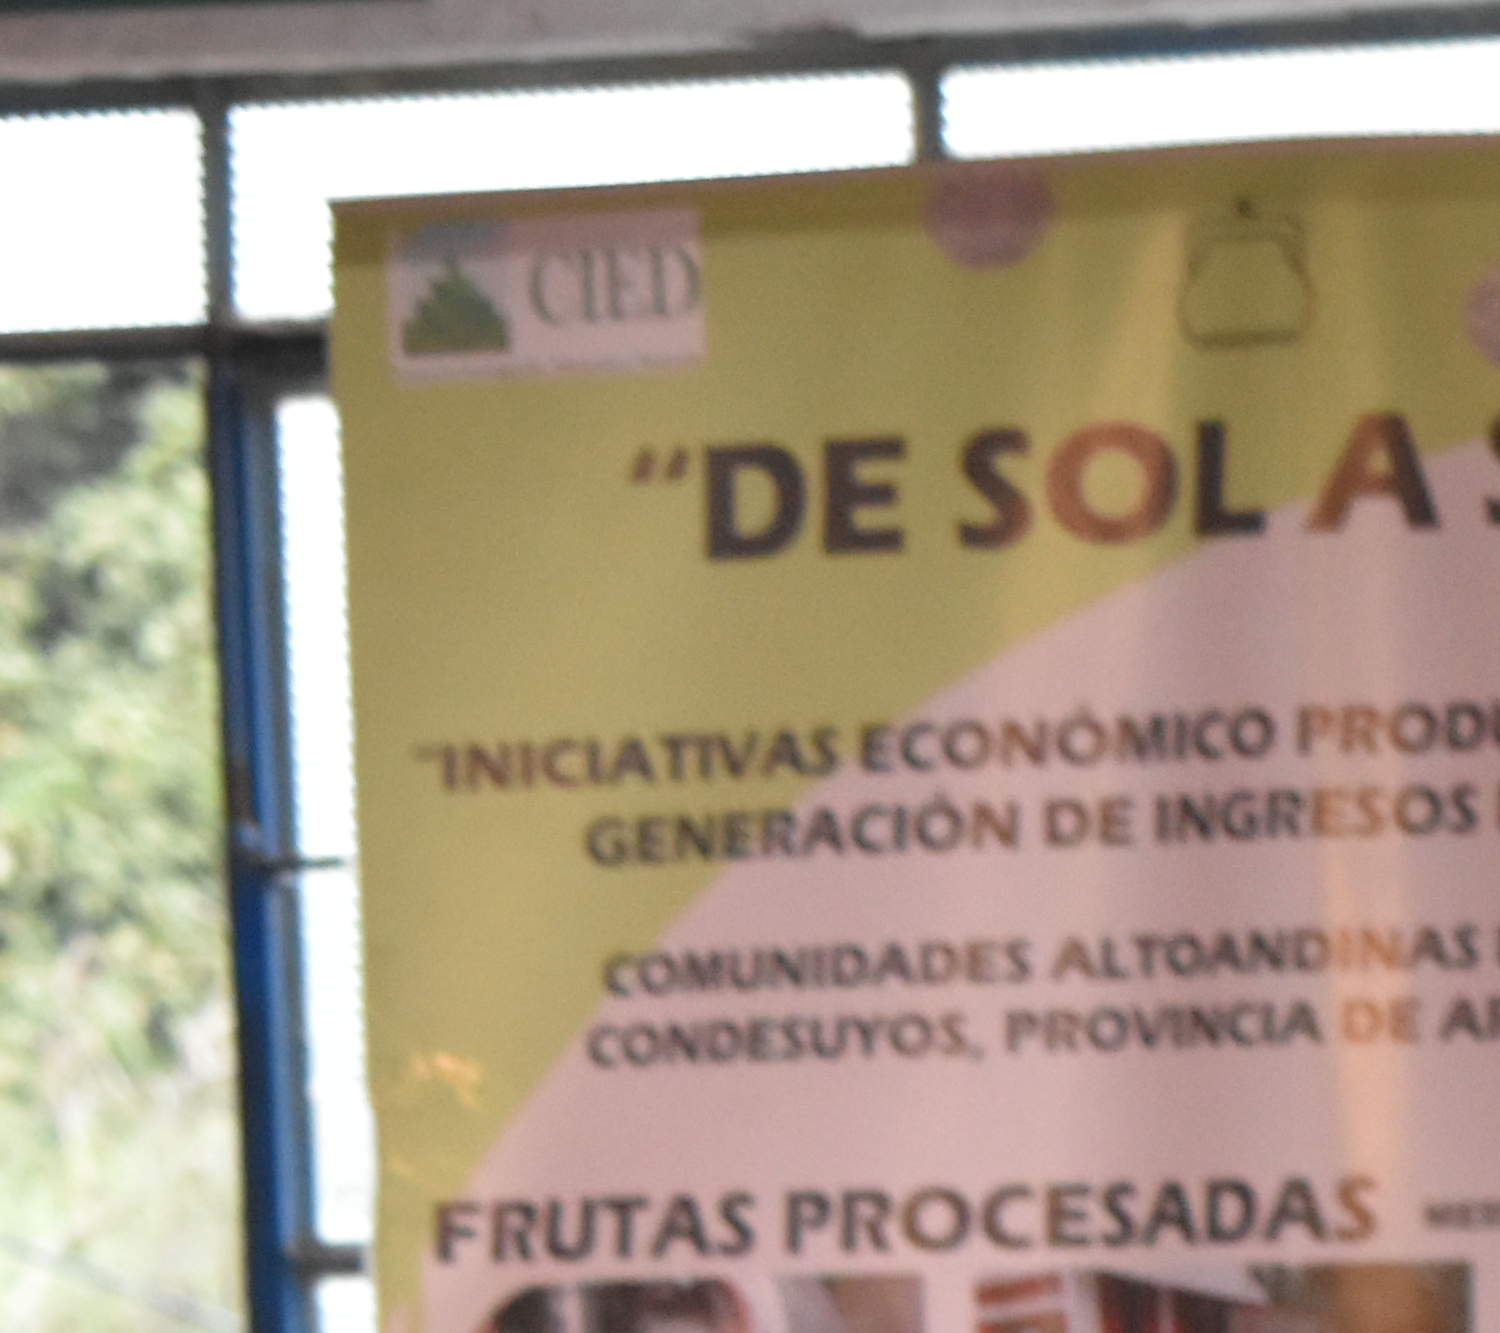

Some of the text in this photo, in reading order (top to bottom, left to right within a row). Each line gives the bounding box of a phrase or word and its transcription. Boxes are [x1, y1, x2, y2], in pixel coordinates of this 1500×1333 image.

[527, 242, 702, 326] CIED
[957, 419, 1268, 550] SOL
[1306, 408, 1443, 532] A
[859, 706, 1275, 774] ECONÓMICO
[586, 794, 1020, 868] GENERACIÓN
[1042, 797, 1134, 847] DE
[1154, 783, 1479, 844] INGRESOS
[603, 938, 1033, 998] COMUNIDADES
[1051, 921, 1479, 982] ALTOANDINAS
[587, 1011, 984, 1069] CONDESUYOS,
[1003, 999, 1323, 1057] PROVINCIA
[1340, 999, 1420, 1045] DE
[434, 1190, 757, 1263] FRUTAS
[784, 1174, 1377, 1254] PROCESADAS
